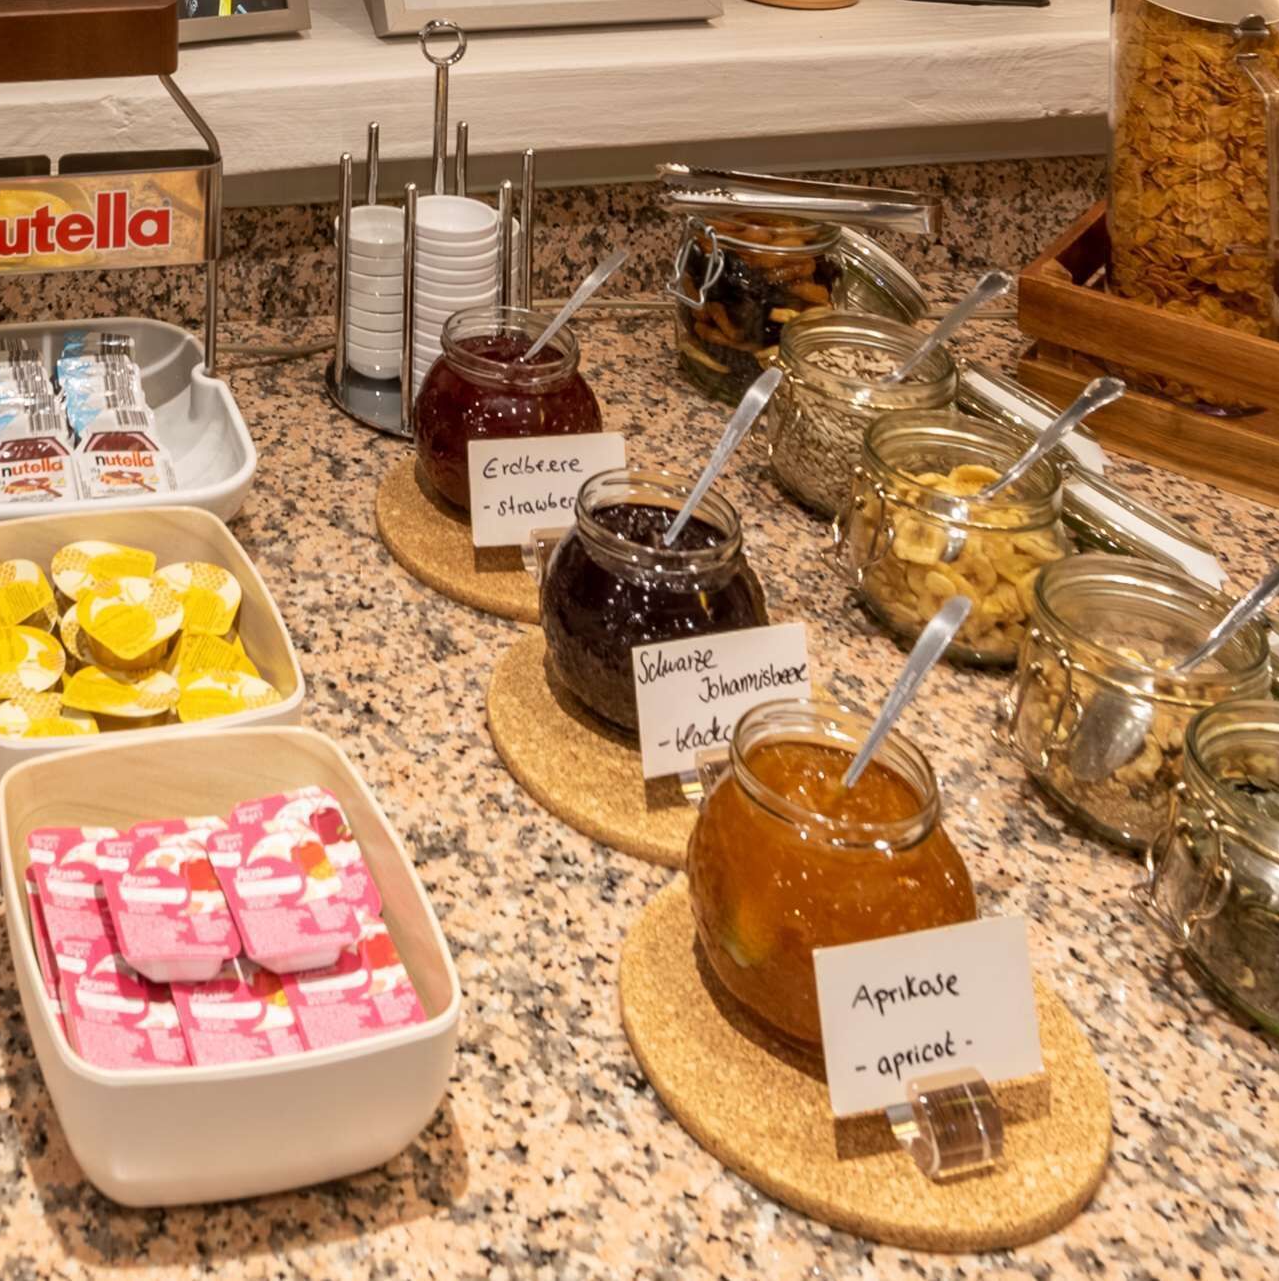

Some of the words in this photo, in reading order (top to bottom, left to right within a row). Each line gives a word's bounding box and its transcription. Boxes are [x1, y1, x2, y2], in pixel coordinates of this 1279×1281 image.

[1, 456, 64, 477] nutella
[95, 450, 155, 468] nutella
[482, 455, 583, 479] Erdbeere
[497, 492, 577, 517] strawber
[877, 1030, 956, 1081] apricot
